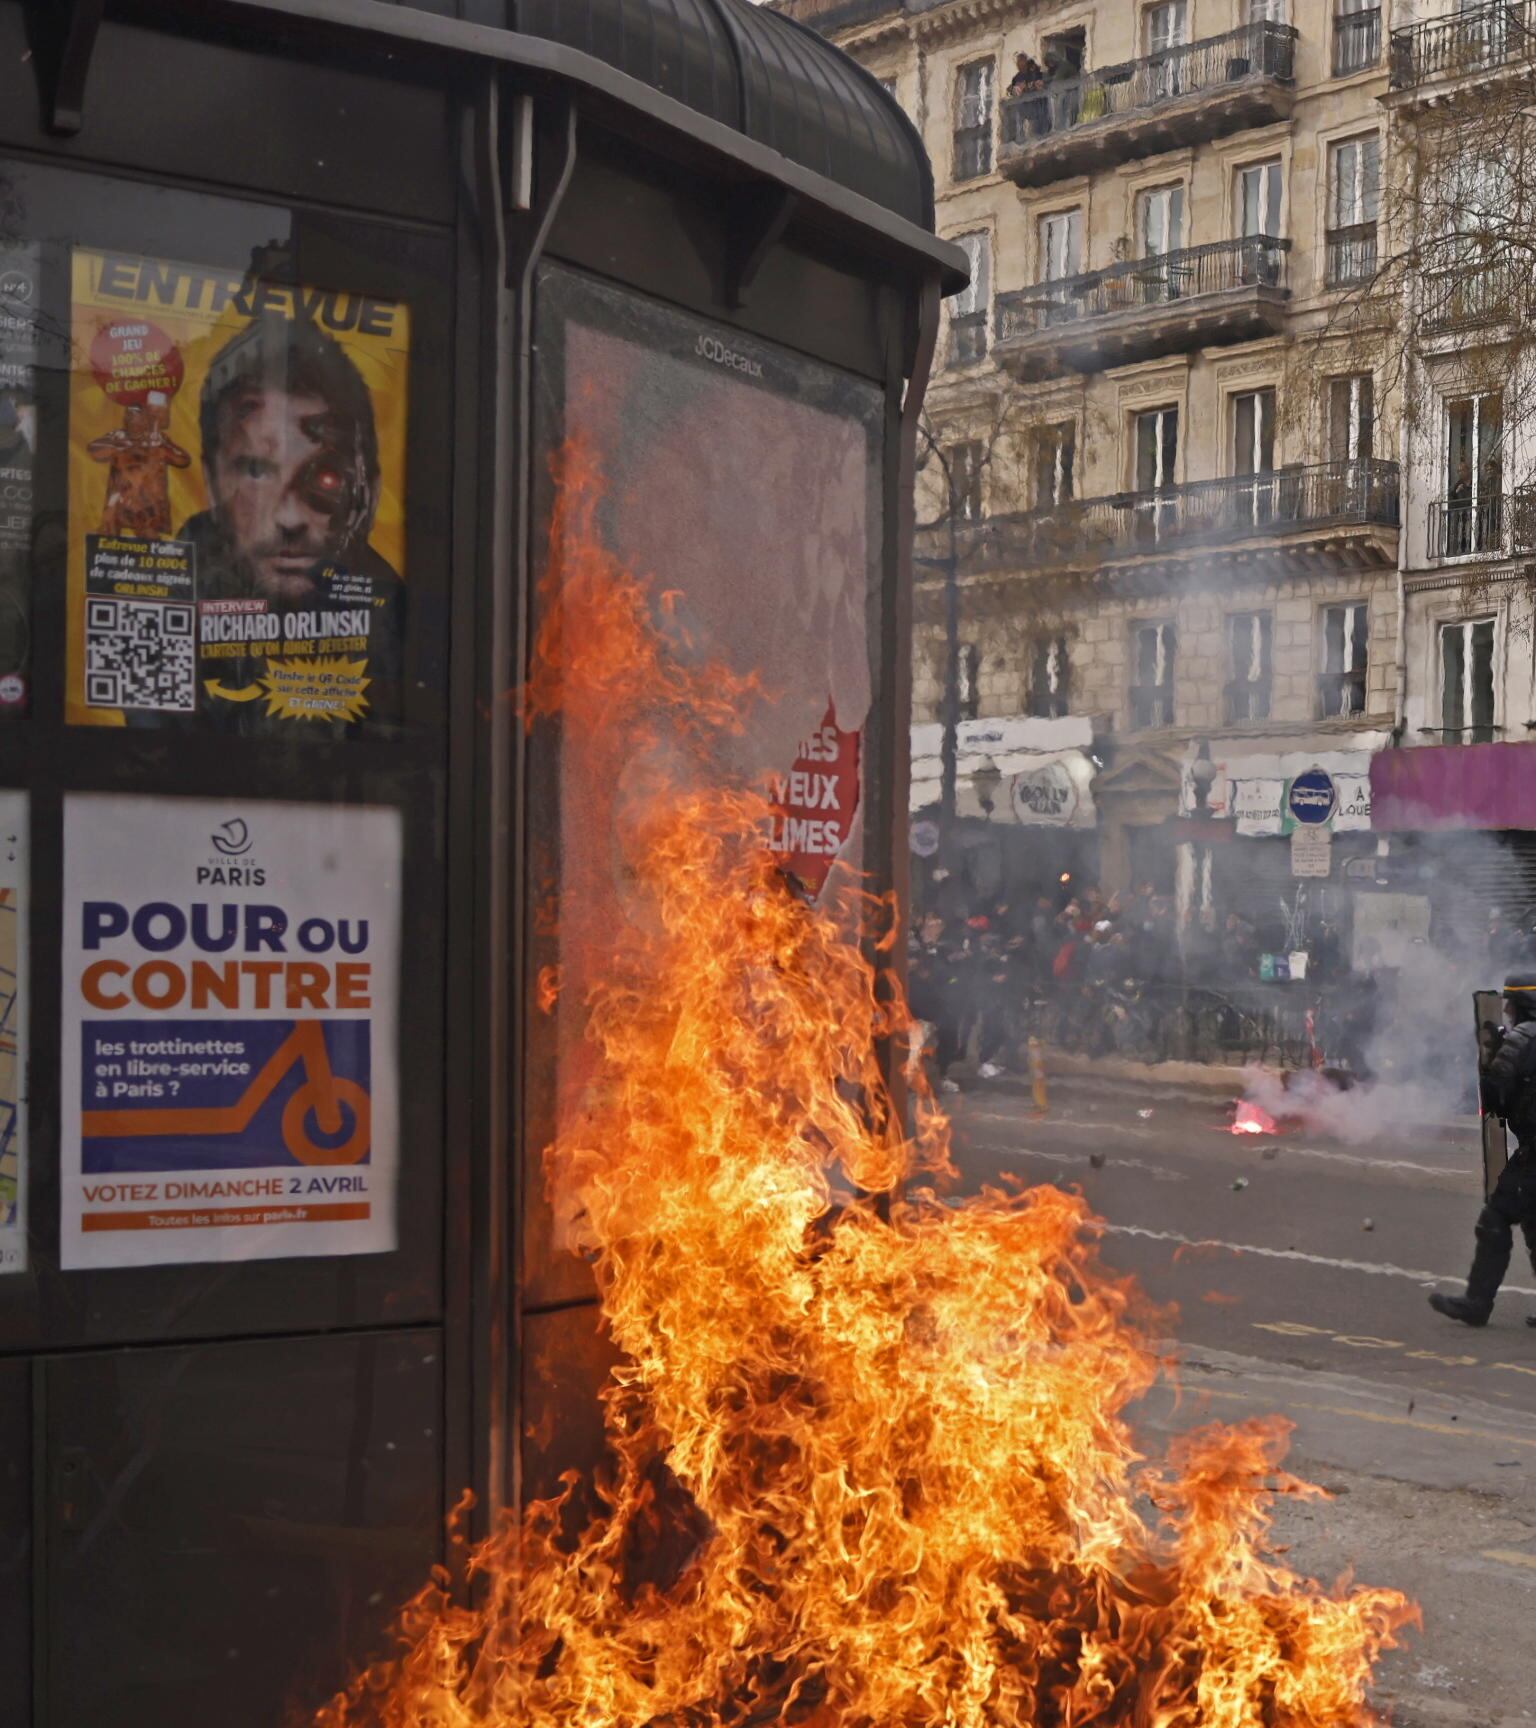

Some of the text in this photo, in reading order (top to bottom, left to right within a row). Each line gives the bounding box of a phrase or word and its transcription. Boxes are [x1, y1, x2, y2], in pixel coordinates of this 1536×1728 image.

[97, 258, 398, 337] ENTREVUE
[110, 325, 149, 338] GRAND
[123, 338, 143, 351] JEU
[694, 335, 765, 379] JCDecaux
[112, 364, 166, 379] CHANCES
[97, 537, 148, 553] Entrevue
[120, 553, 135, 567] de
[138, 556, 154, 569] 10
[89, 566, 105, 578] de
[113, 582, 169, 597] ORLINSKI
[202, 602, 265, 613] INTERVIEW
[200, 610, 369, 642] RICHARD ORLINSKI
[768, 815, 842, 854] LIMES
[242, 858, 256, 866] DE
[196, 866, 266, 887] PARIS
[82, 901, 369, 955] POUR OU
[80, 960, 371, 1010] CONTRE
[95, 1038, 245, 1056] les trottinettes
[95, 1059, 251, 1078] en libre-service
[95, 1080, 181, 1099] à Paris ?
[82, 1175, 368, 1202] VOTEZ DIMANCHE 2 AVRIL
[147, 1208, 307, 1228] Toutes les infos sur paris.fr
